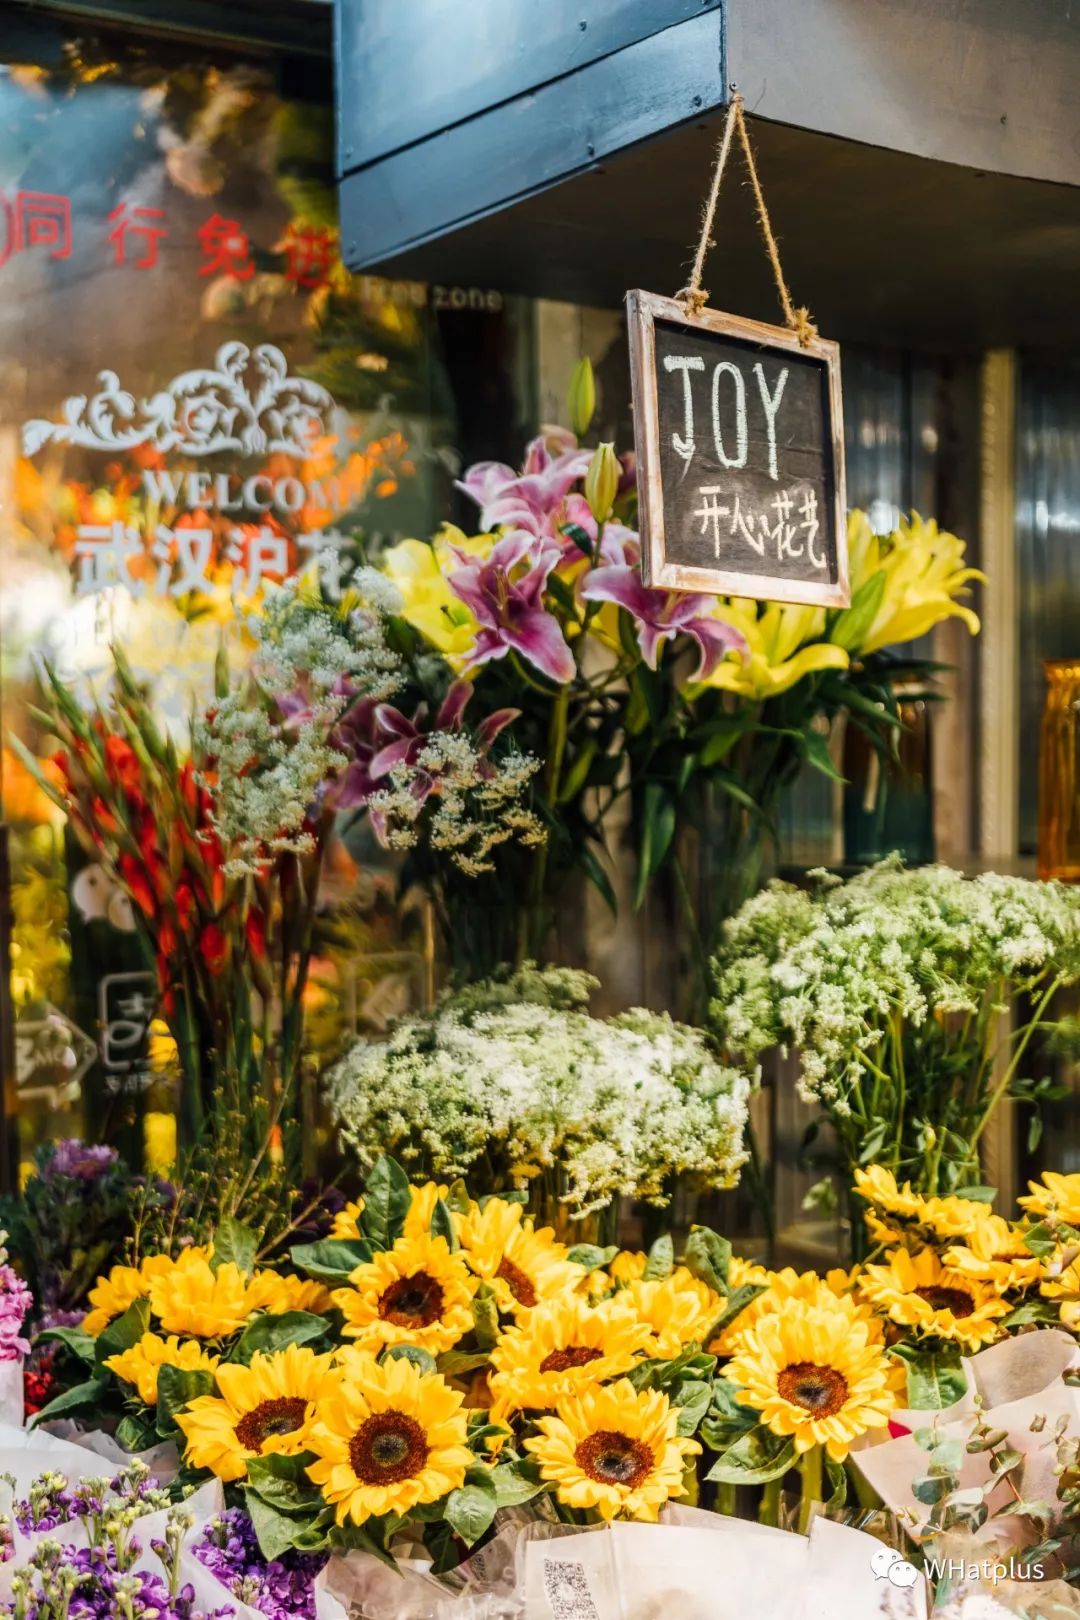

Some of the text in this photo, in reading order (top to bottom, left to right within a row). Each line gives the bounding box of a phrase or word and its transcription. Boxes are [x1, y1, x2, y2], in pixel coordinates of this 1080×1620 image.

[433, 285, 502, 312] zone
[663, 354, 790, 481] JOY
[143, 470, 368, 513] WELCOM
